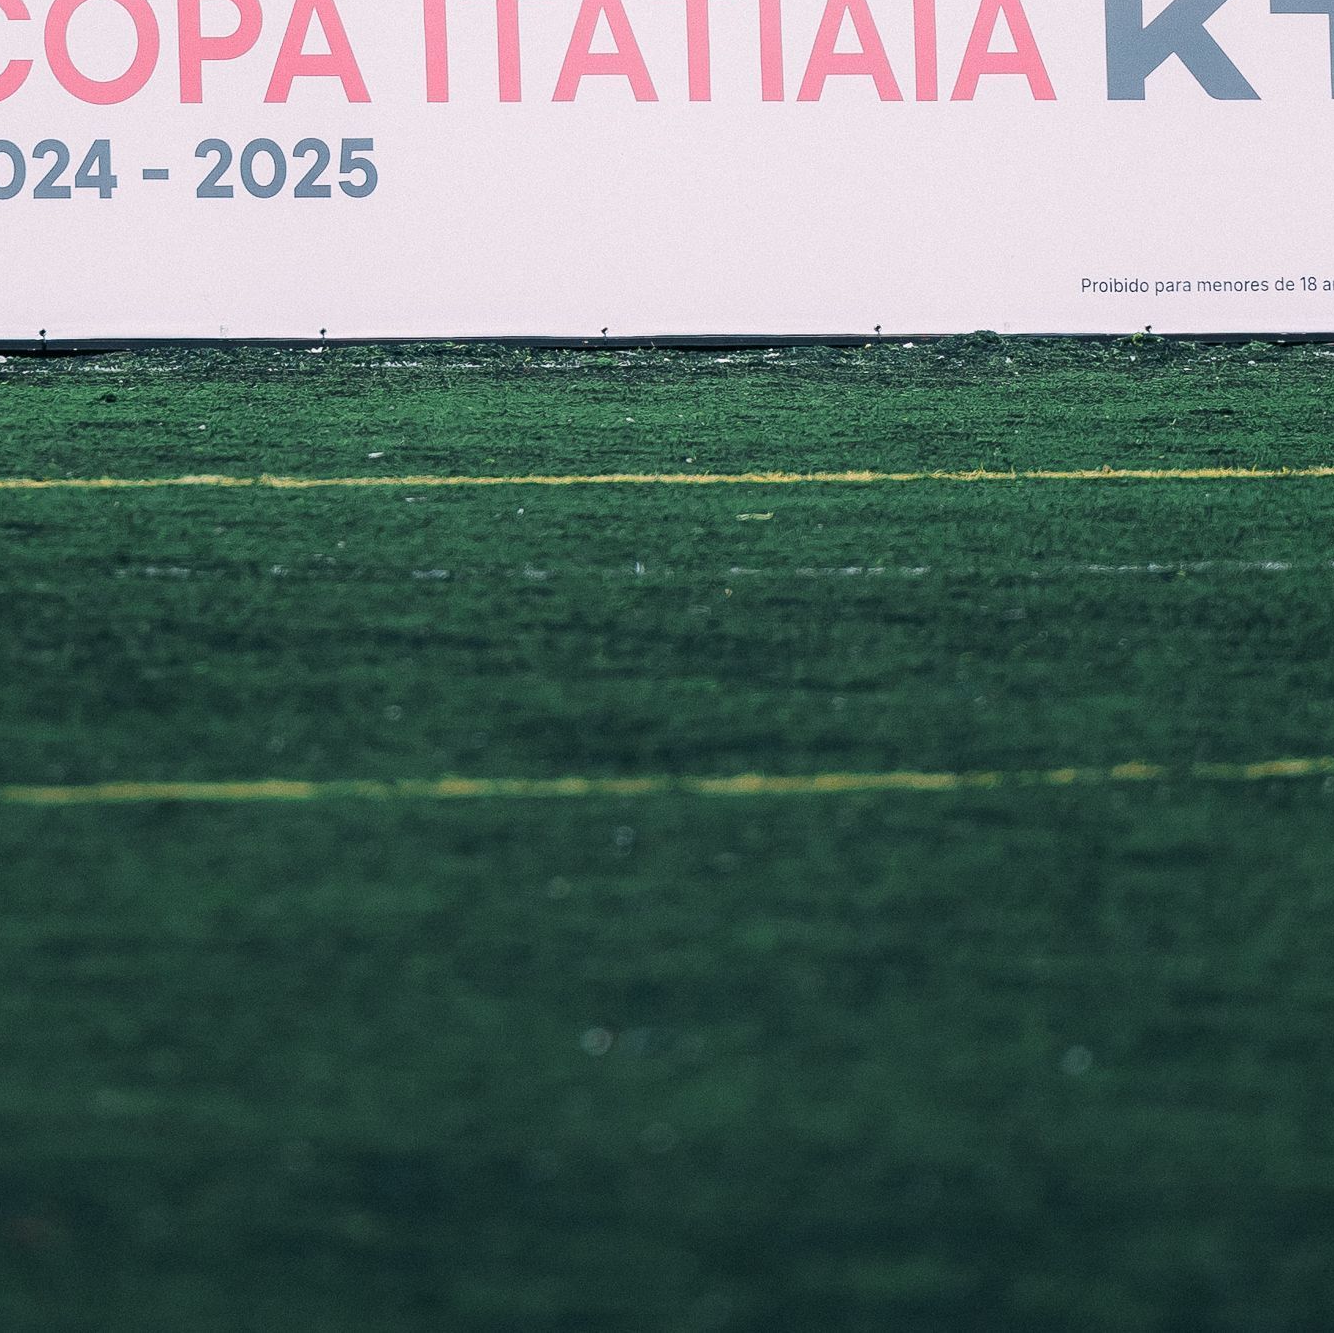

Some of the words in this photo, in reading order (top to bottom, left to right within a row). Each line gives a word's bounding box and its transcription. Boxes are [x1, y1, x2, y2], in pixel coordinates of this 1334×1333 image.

[143, 169, 170, 182] -
[195, 138, 380, 200] 2025
[1081, 277, 1150, 294] Proibido
[1155, 281, 1192, 297] para
[1197, 280, 1269, 293] menores
[1275, 276, 1296, 293] de
[1300, 276, 1319, 292] 18
